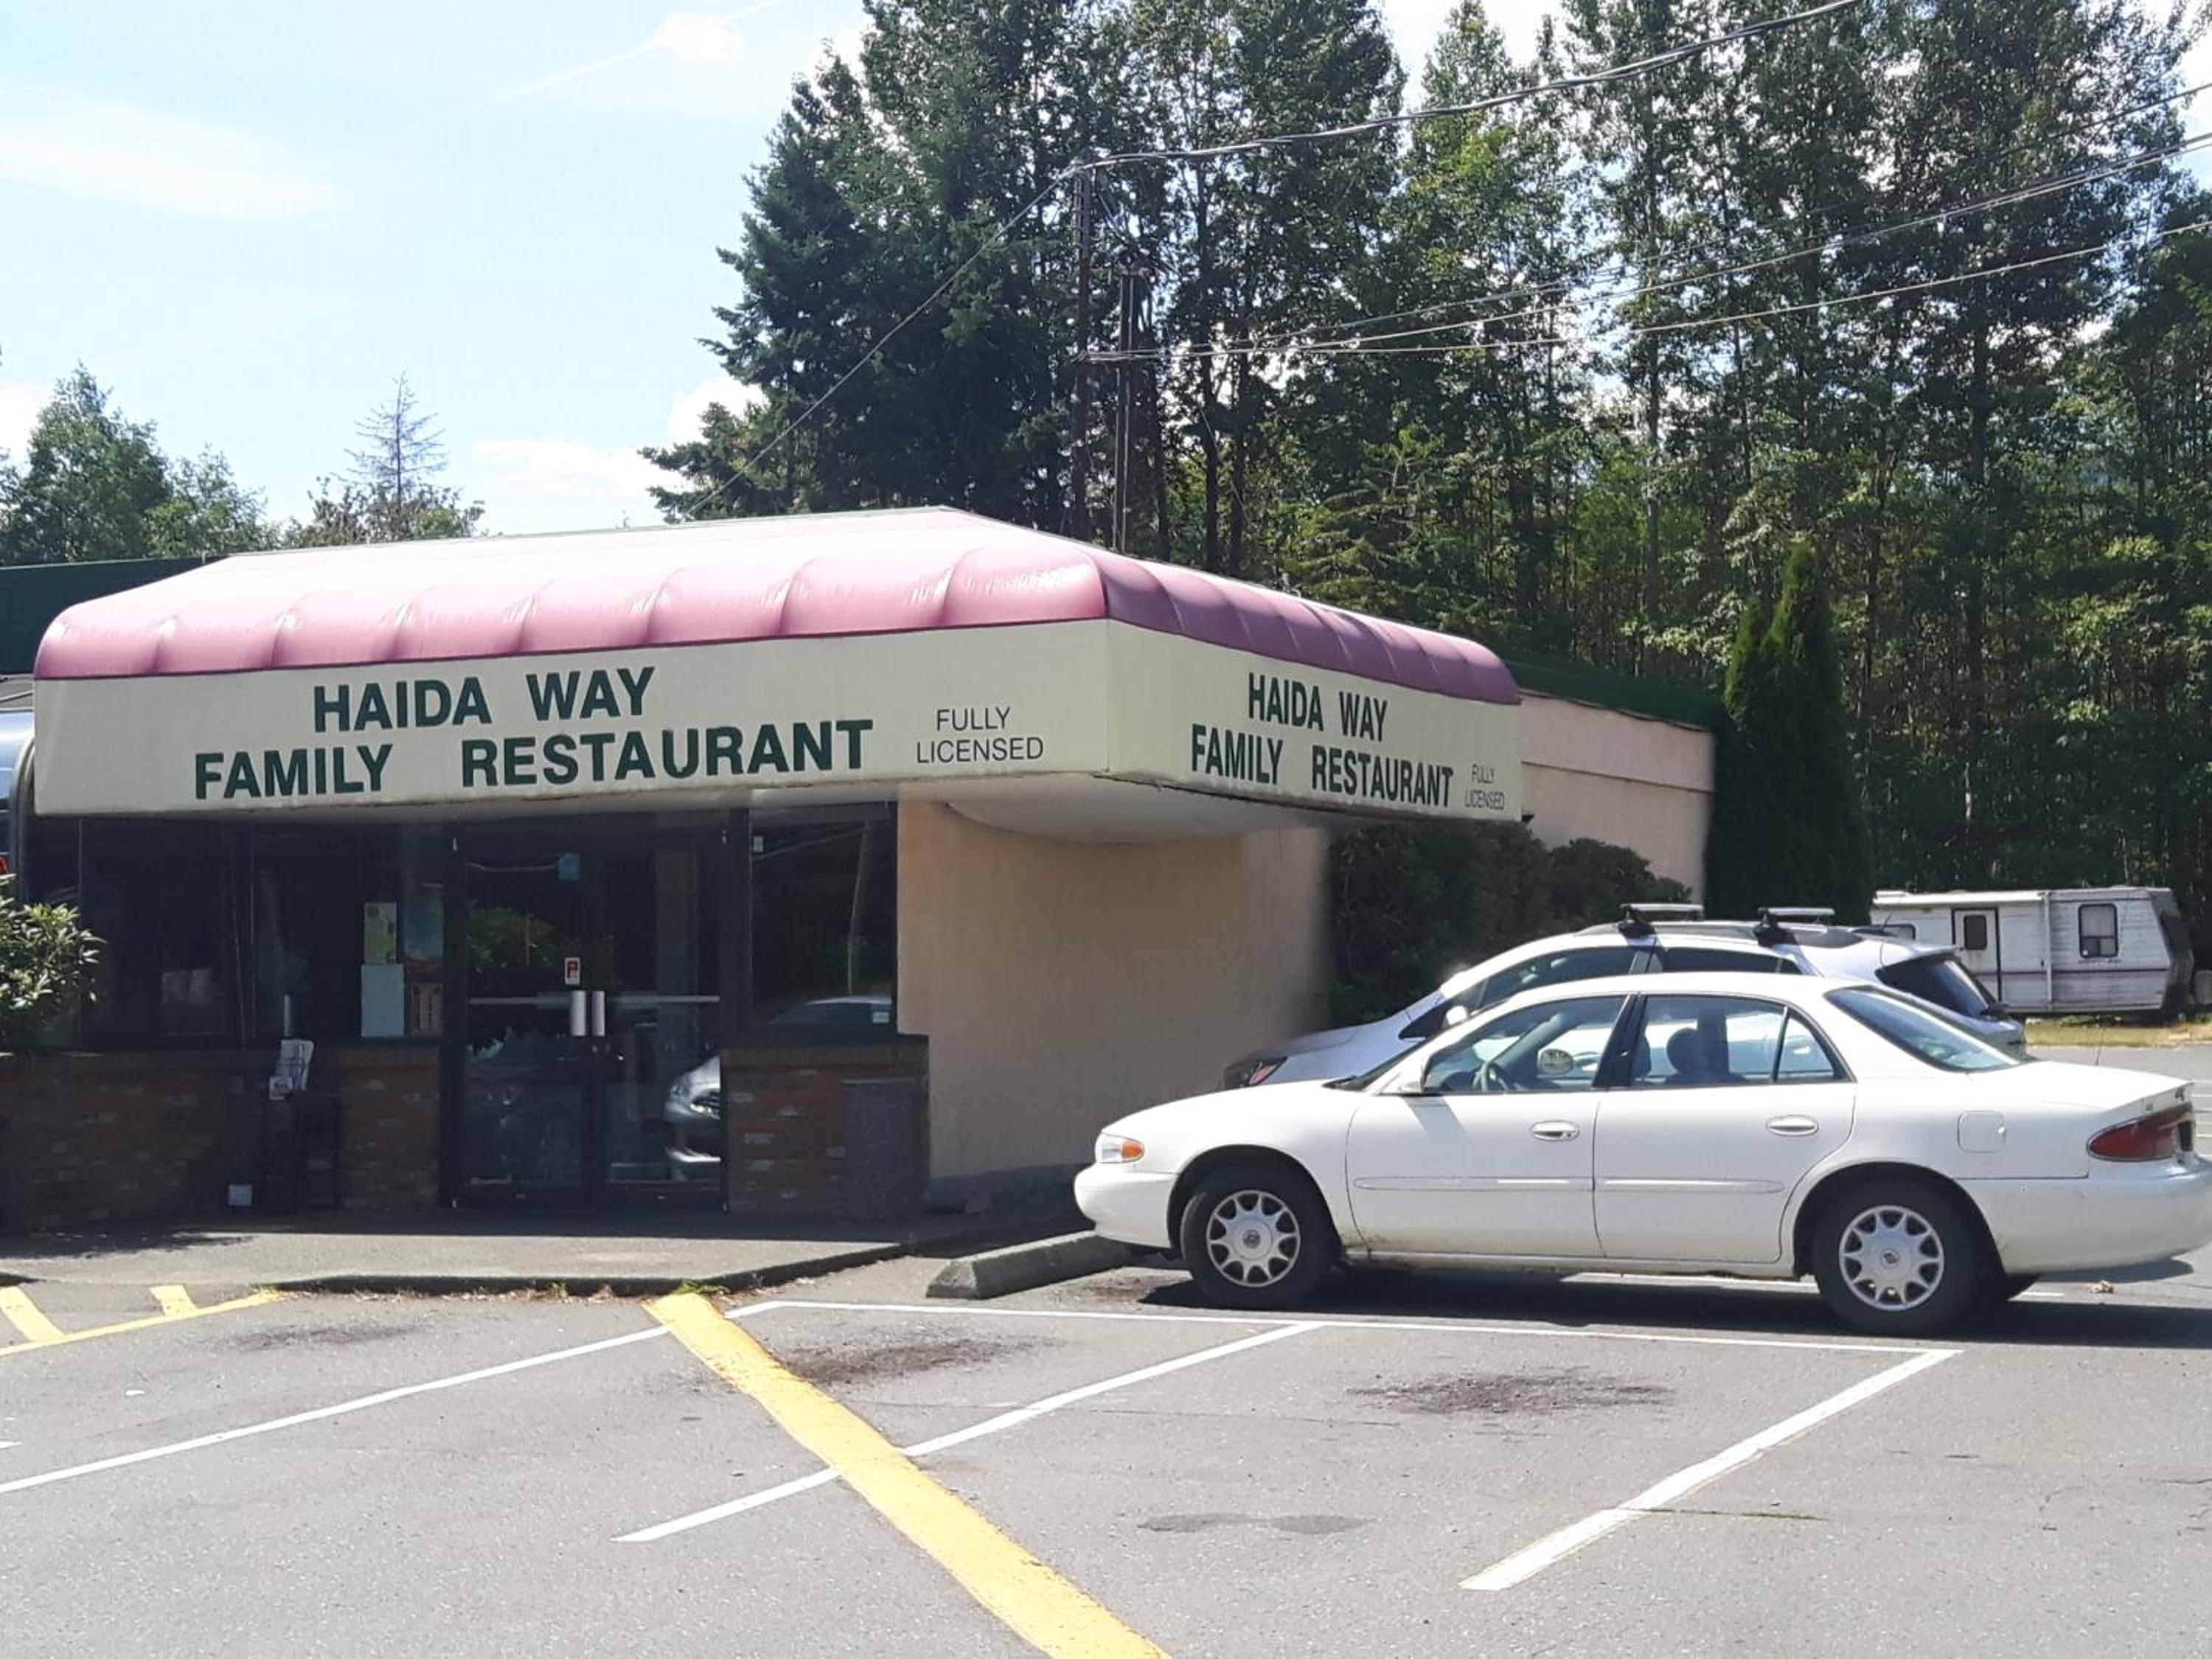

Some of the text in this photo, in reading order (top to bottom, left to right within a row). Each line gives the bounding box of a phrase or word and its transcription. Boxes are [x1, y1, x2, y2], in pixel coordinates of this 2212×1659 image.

[313, 666, 655, 733] HAIDA WAY
[936, 706, 1011, 732] FULLY
[1248, 672, 1388, 742] HAIDA WAY
[195, 719, 874, 800] FAMILY RESTAURANT
[917, 737, 1044, 764] LICENSED
[1192, 723, 1454, 808] FAMILY RESTAURANT
